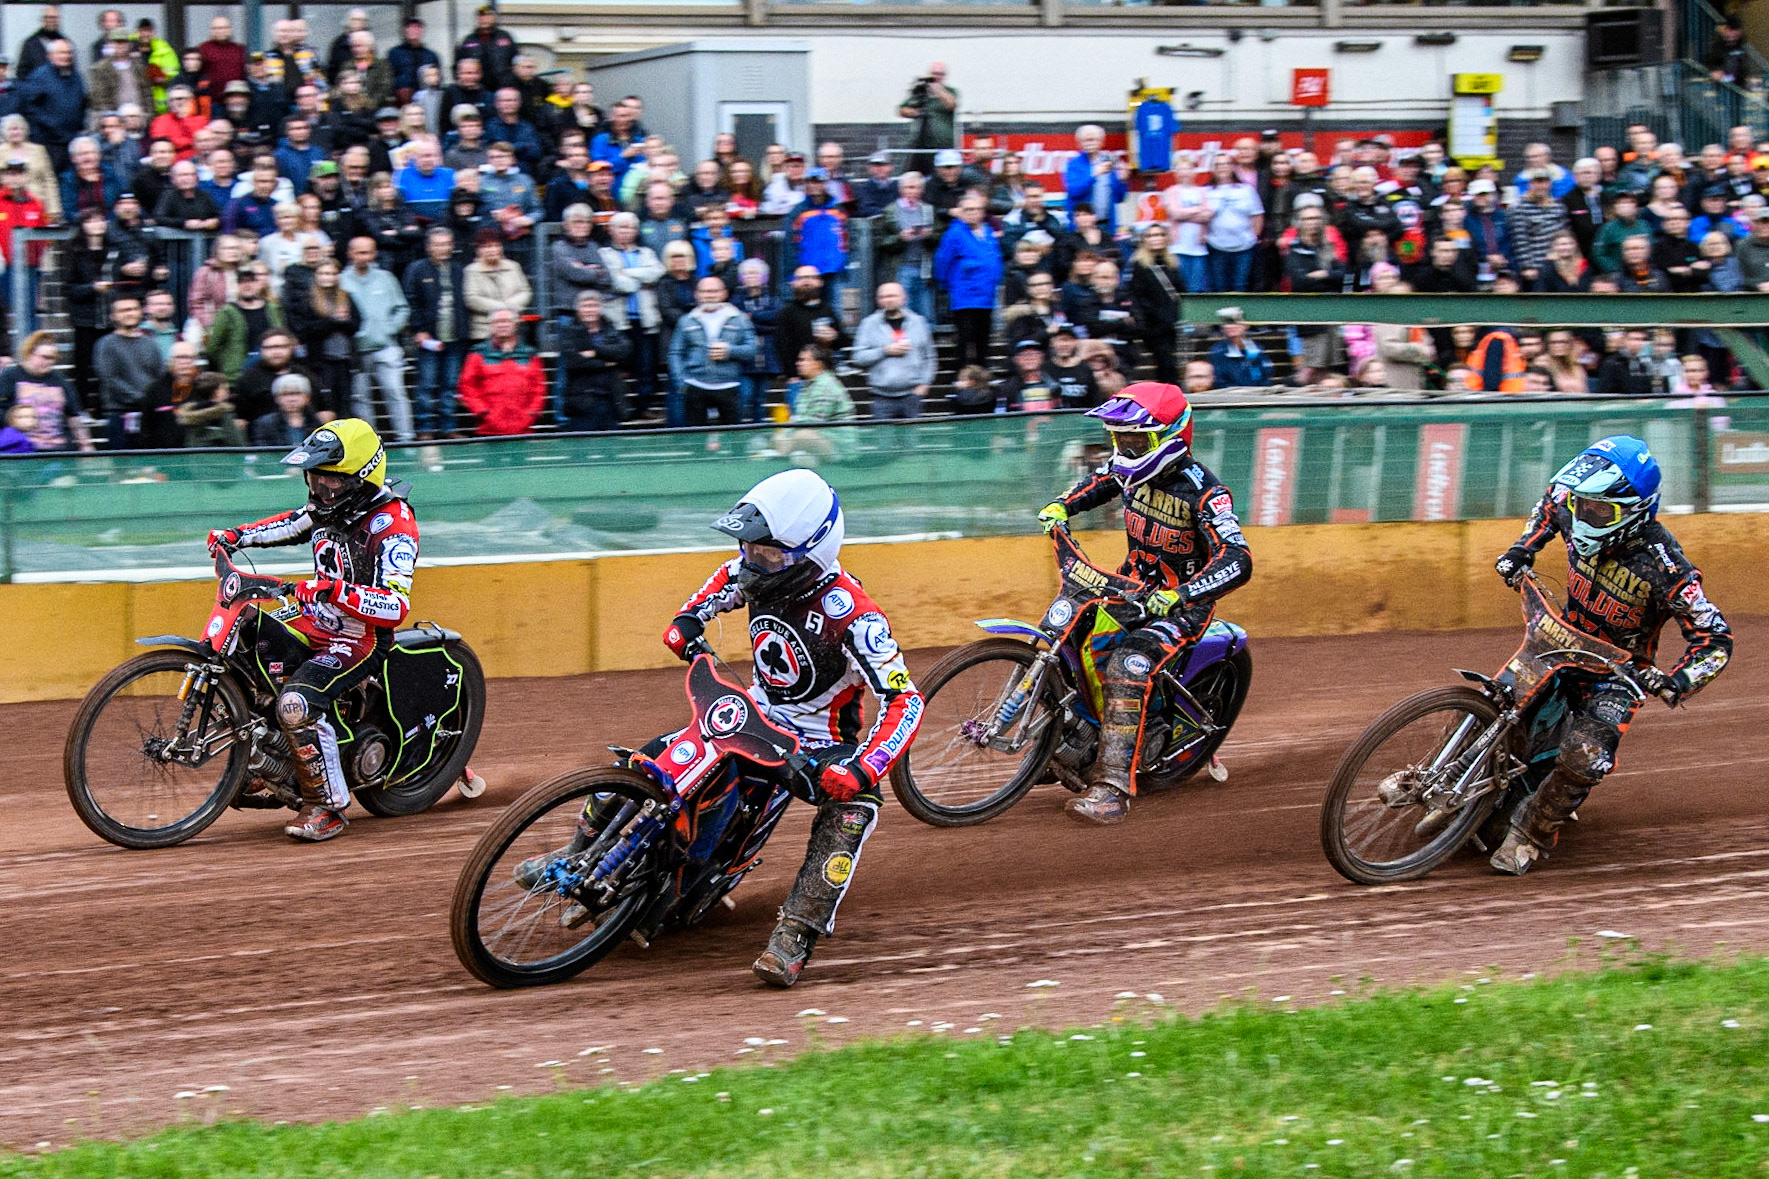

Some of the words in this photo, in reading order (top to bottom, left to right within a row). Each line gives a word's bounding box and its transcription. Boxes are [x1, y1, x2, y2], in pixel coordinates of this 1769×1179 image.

[1071, 560, 1109, 591] PARRYS
[1186, 561, 1195, 575] 5
[1580, 554, 1652, 598] ARRYS
[363, 599, 399, 611] PLASTICS
[828, 593, 846, 611] ATPI
[360, 607, 377, 616] LTD
[808, 613, 821, 633] 5
[772, 621, 791, 639] VUE
[790, 640, 808, 667] ACES
[446, 674, 458, 685] 27
[885, 695, 922, 753] burnside
[677, 747, 691, 759] ATPI
